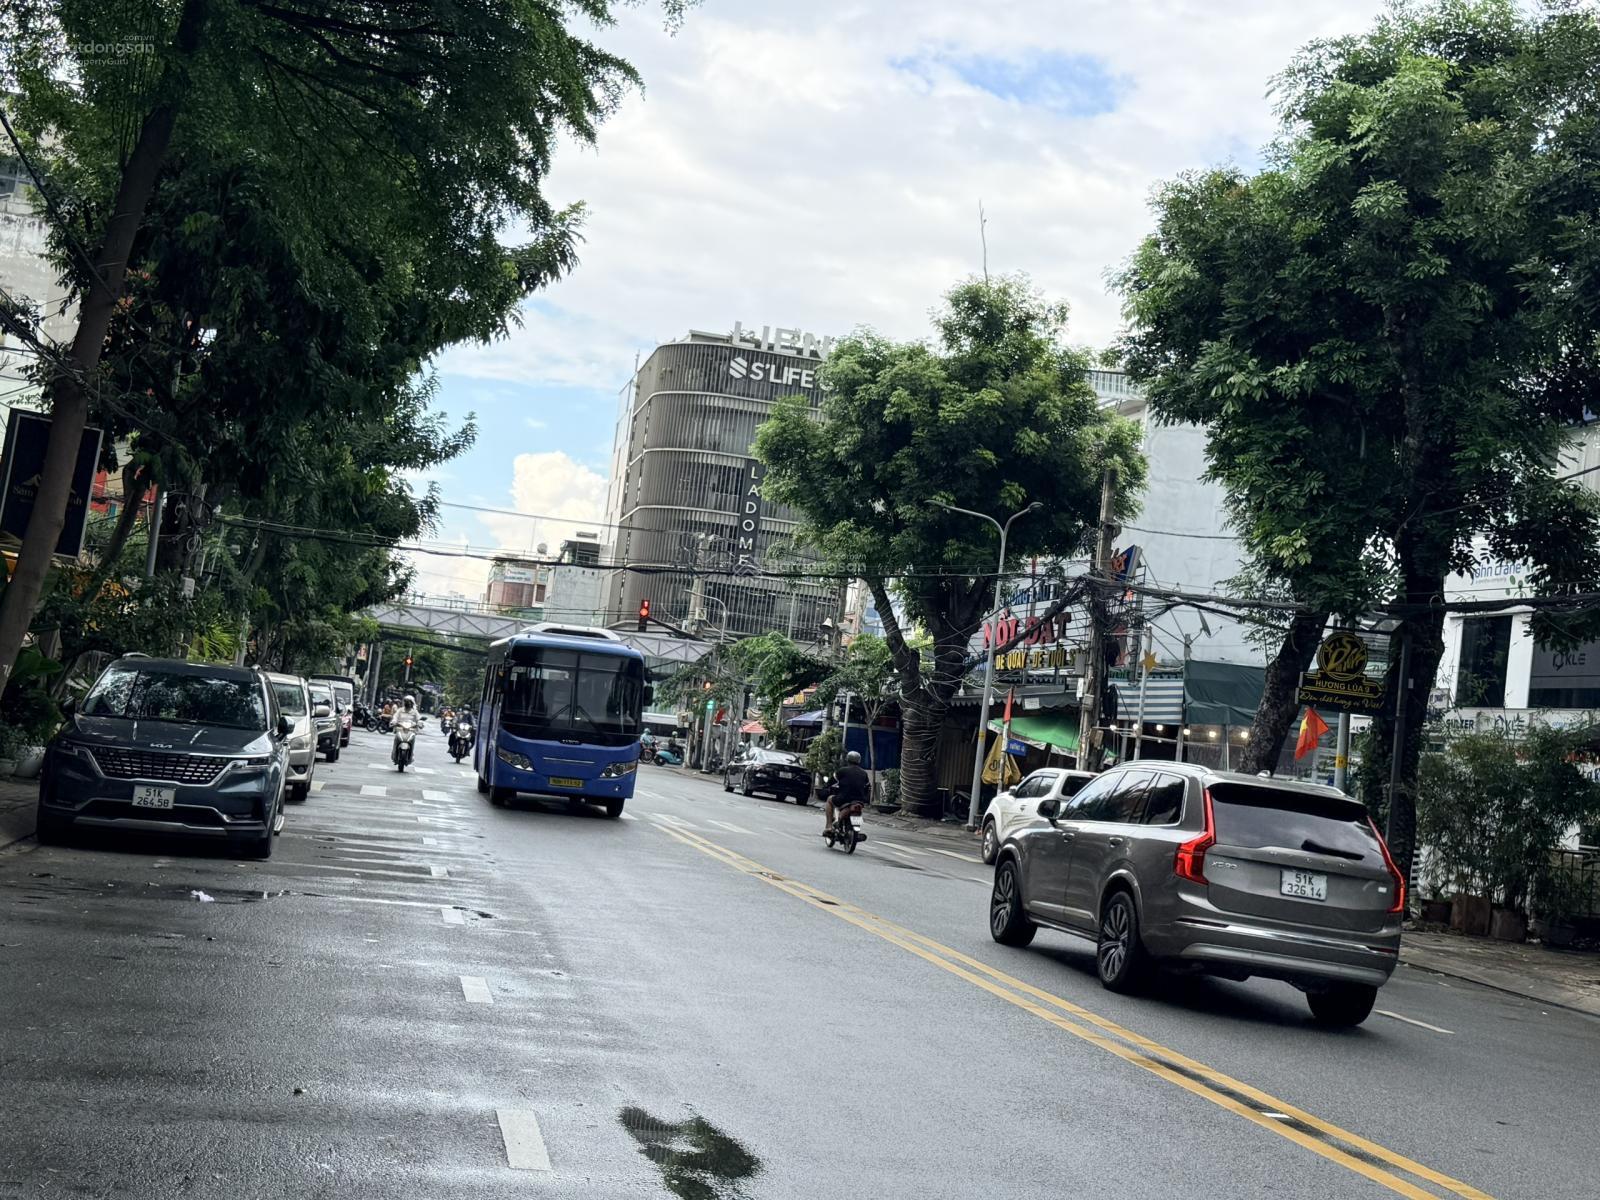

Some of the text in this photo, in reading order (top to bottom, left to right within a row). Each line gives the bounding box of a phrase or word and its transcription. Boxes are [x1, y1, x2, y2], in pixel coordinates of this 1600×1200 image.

[749, 361, 815, 389] S'LIFE
[145, 787, 163, 798] 51K
[136, 796, 170, 808] 264.58
[1295, 873, 1314, 886] 51K
[1287, 883, 1322, 898] 326.14
